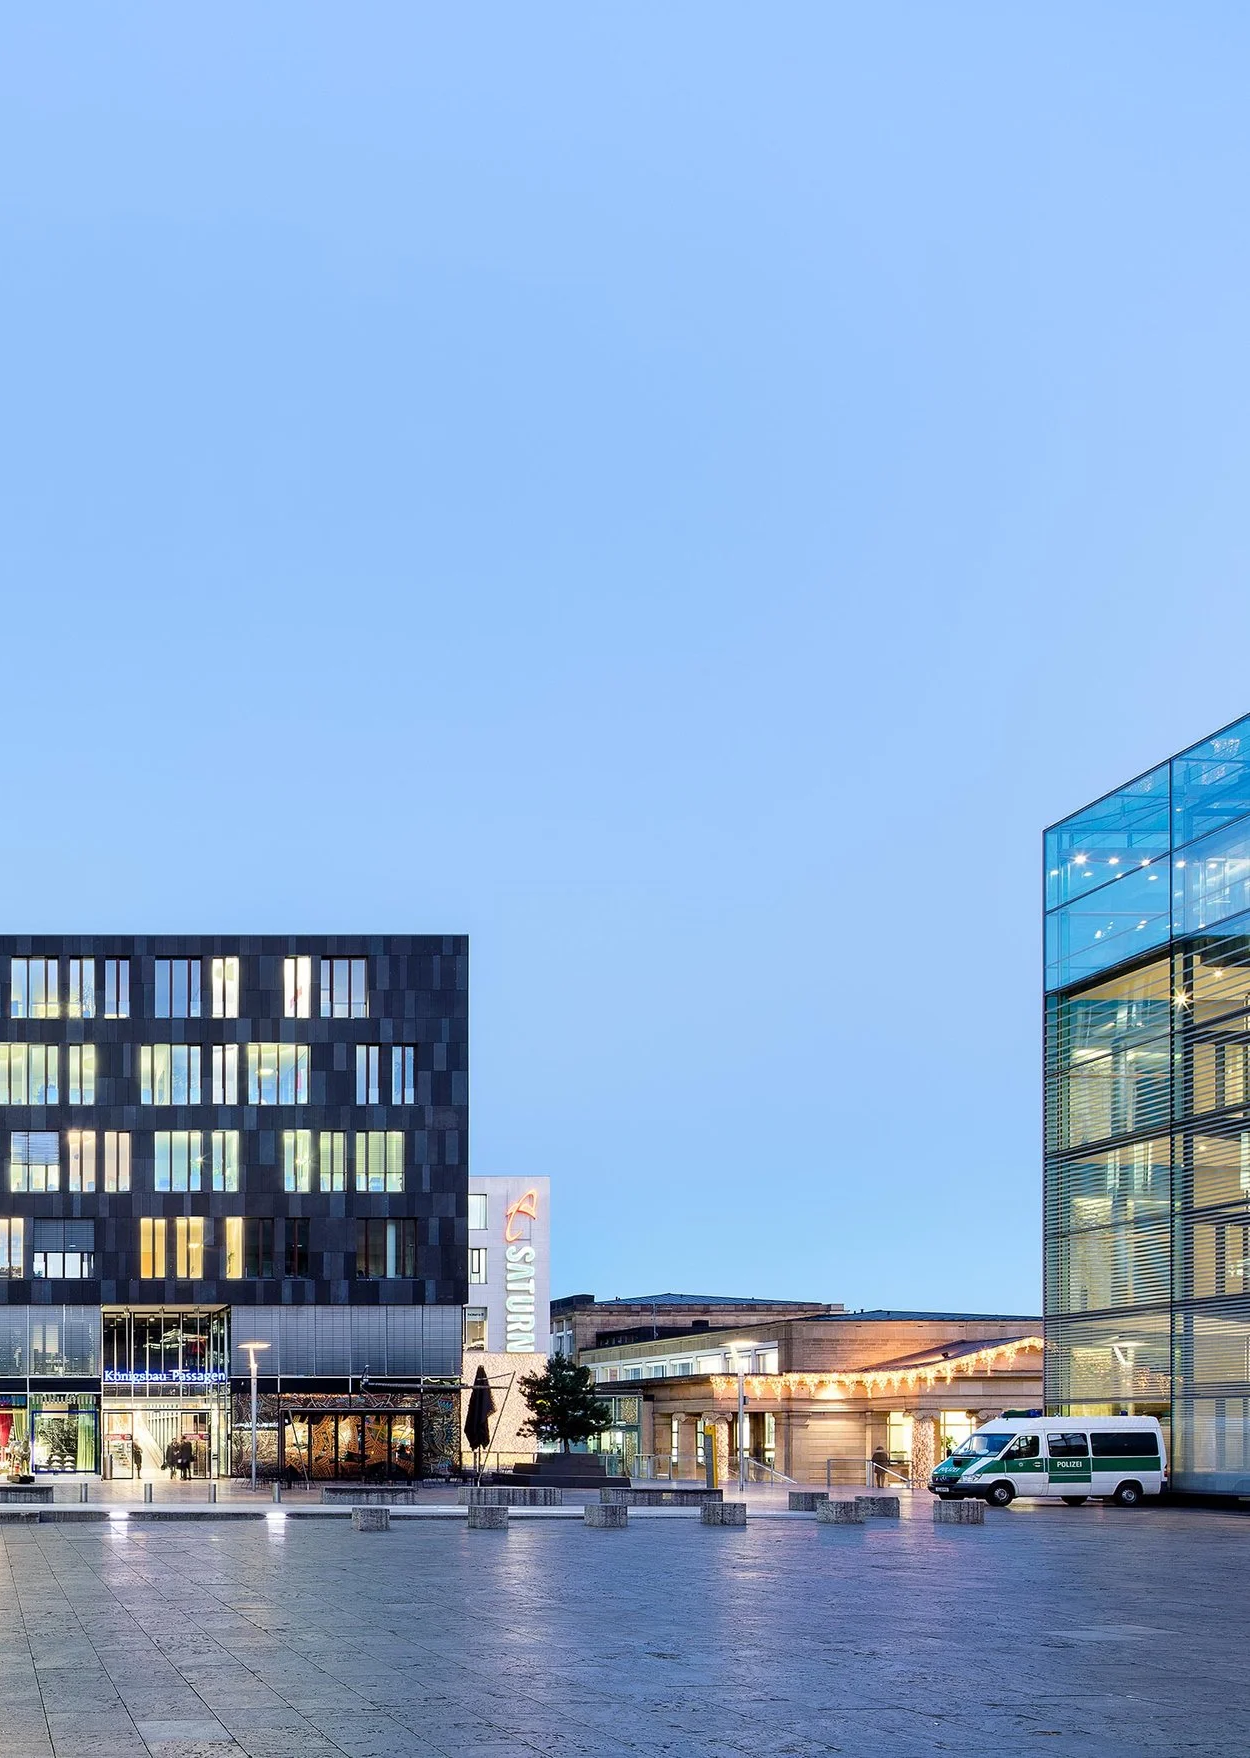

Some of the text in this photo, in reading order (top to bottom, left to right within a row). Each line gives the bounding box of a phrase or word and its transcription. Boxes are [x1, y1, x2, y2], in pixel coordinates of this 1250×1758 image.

[505, 1245, 536, 1353] SATURN
[104, 1370, 226, 1383] Königsbau Passagen
